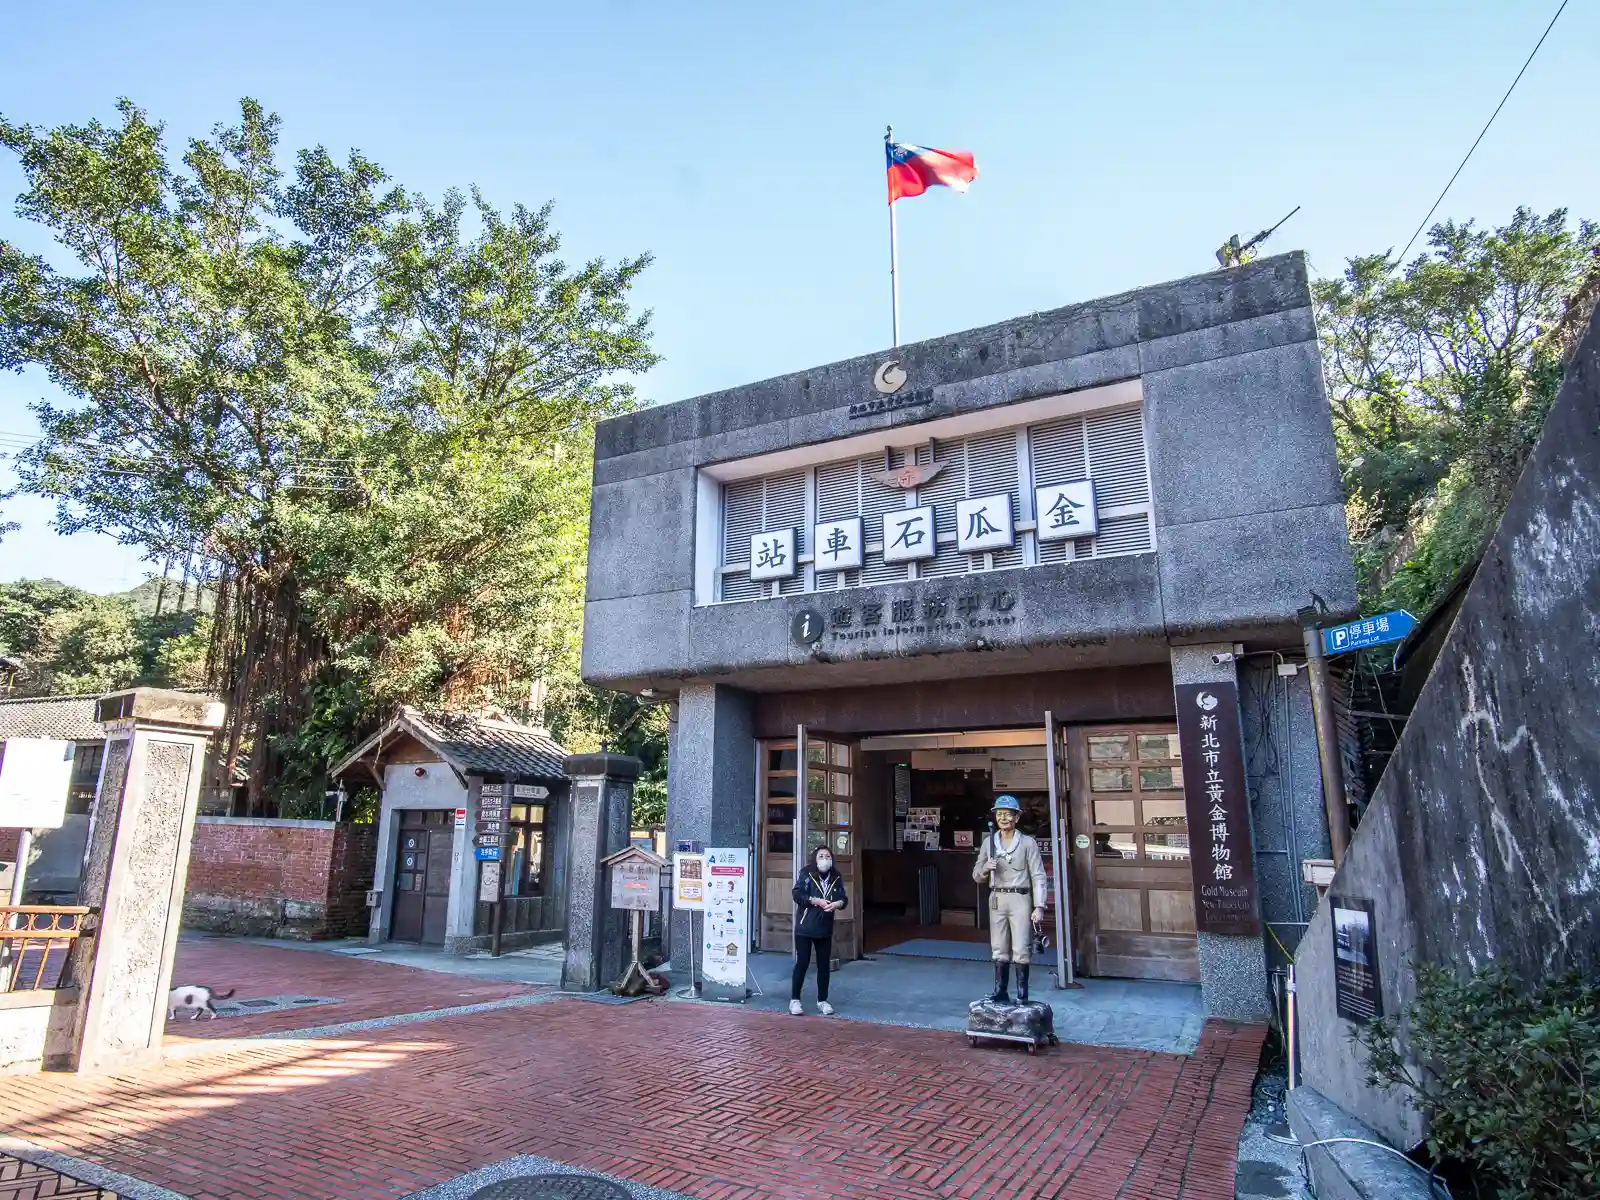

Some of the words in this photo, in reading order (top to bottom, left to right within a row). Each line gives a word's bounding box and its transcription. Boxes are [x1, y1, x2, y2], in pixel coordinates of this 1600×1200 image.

[832, 628, 877, 641] Tourist
[883, 621, 962, 637] Information
[969, 616, 1016, 629] Center
[1335, 630, 1346, 646] P
[1349, 616, 1390, 640] 停車場
[1350, 638, 1370, 647] Parking
[1199, 714, 1234, 881] 新北市立黃金博物館
[1201, 884, 1218, 896] Gold
